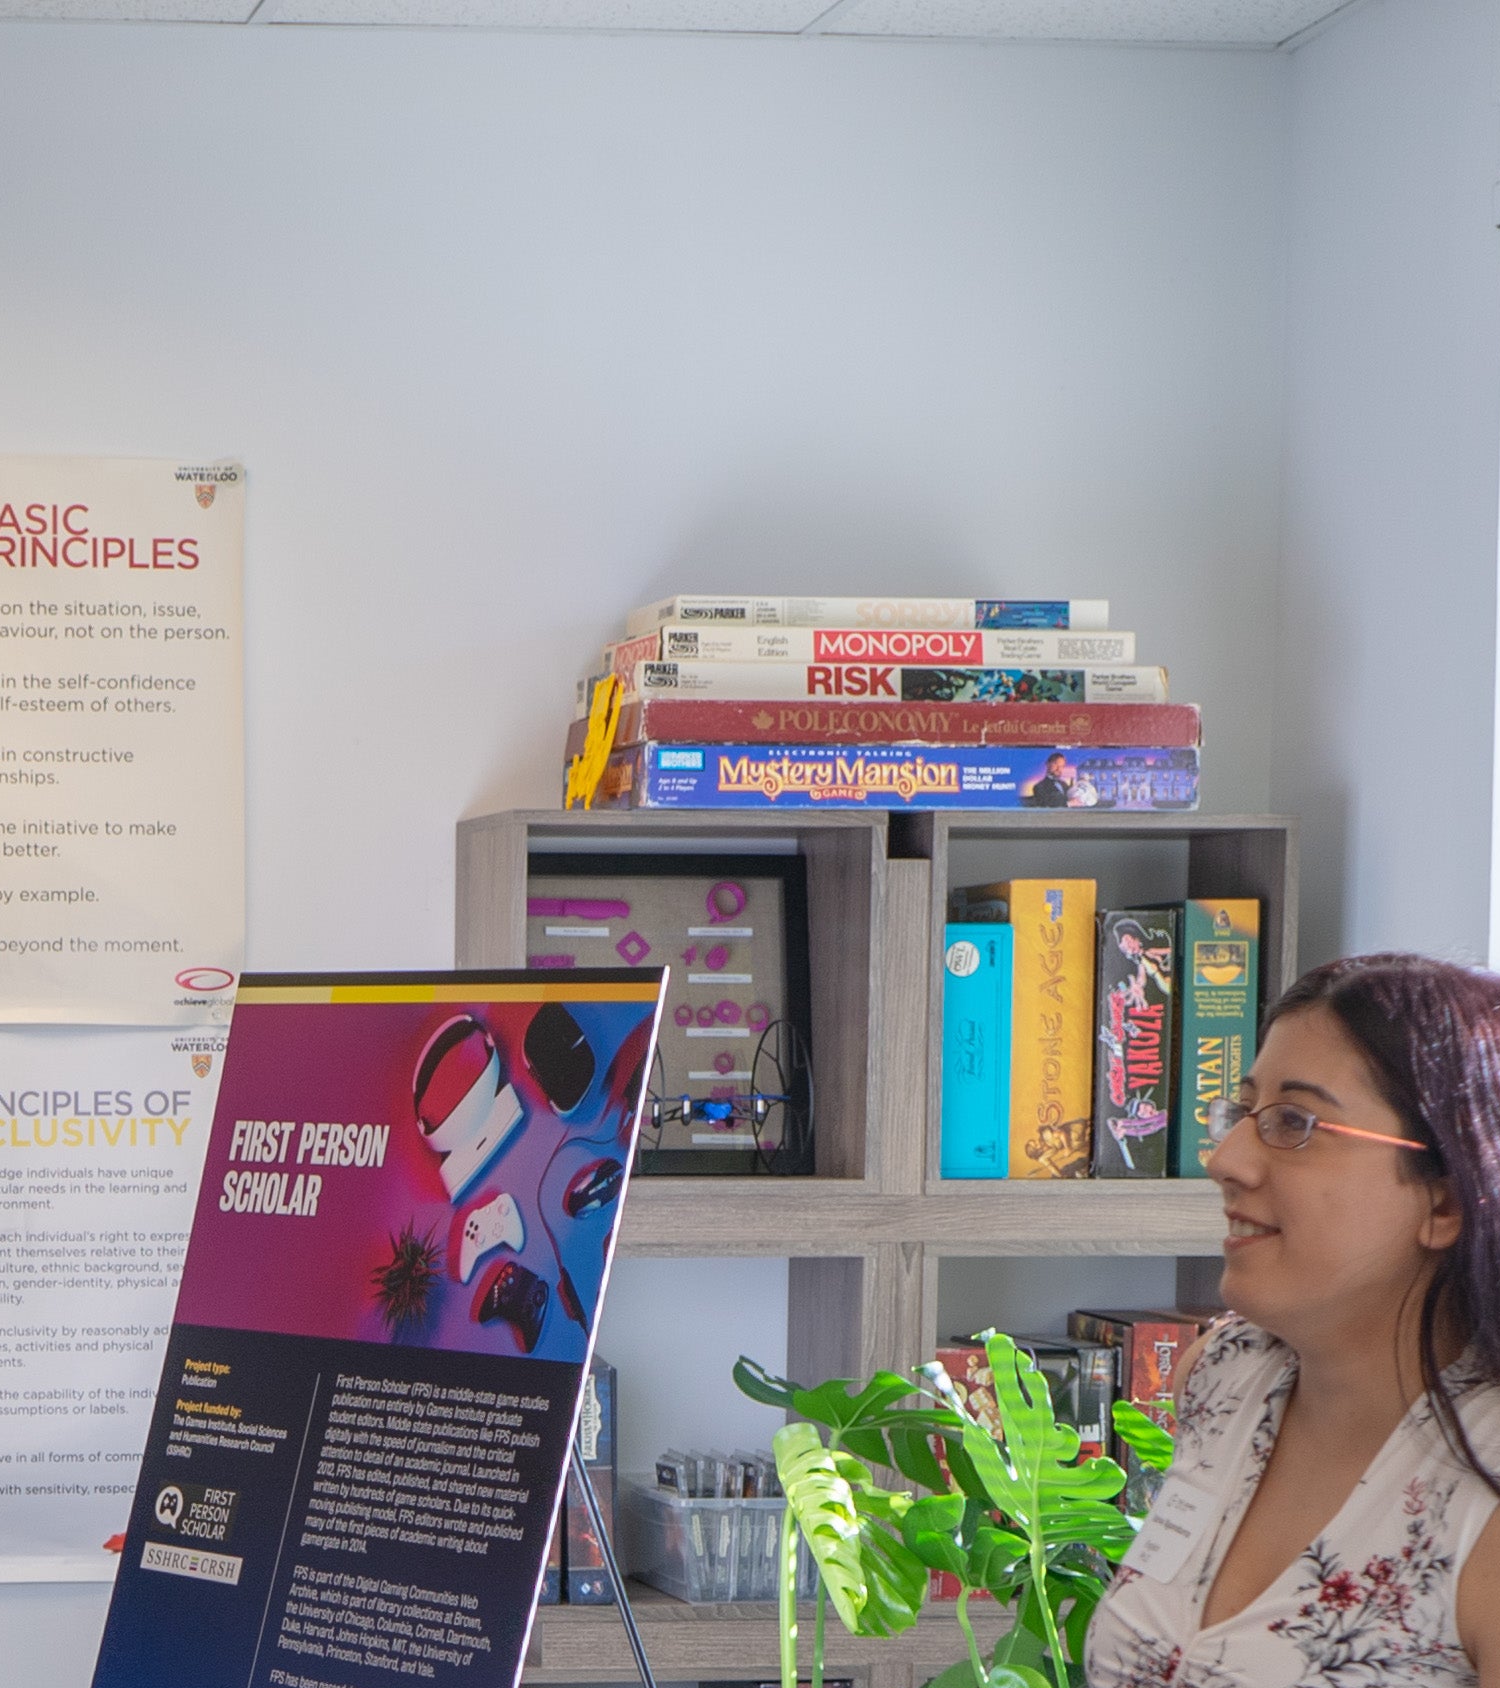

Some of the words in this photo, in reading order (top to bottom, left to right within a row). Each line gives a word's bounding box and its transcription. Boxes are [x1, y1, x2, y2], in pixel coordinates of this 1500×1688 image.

[0, 603, 24, 616] on
[28, 599, 59, 617] the
[63, 600, 147, 619] situation,
[152, 601, 202, 620] issue,
[854, 602, 973, 628] SORRY!
[63, 624, 95, 640] not
[99, 626, 124, 640] on
[128, 623, 159, 640] the
[163, 627, 231, 643] person.
[757, 635, 788, 646] English
[758, 648, 788, 657] Edition
[818, 632, 977, 658] MONOPOLY
[22, 673, 53, 690] the
[57, 673, 197, 692] self-confidence
[806, 665, 898, 697] RISK
[89, 696, 109, 713] of
[113, 697, 176, 714] others.
[778, 708, 952, 735] POLECONOMY
[962, 719, 980, 734] Le
[22, 747, 135, 764] constructive
[768, 749, 848, 757] ELECTRONIC
[718, 755, 832, 800] Mystery
[834, 756, 960, 801] Mansion
[822, 788, 853, 798] GAME
[22, 820, 99, 836] initiative
[104, 821, 124, 836] to
[128, 820, 178, 837] make
[2, 841, 63, 858] better.
[18, 886, 100, 905] example.
[69, 937, 99, 953] the
[104, 938, 184, 953] moment.
[1038, 922, 1066, 1004] AGE
[170, 1042, 227, 1053] WATERLO
[1126, 1003, 1165, 1090] YAKUZA
[1037, 1011, 1064, 1129] STONE
[143, 1090, 192, 1118] OF
[229, 1120, 296, 1163] FIRST
[296, 1122, 390, 1167] PERSON
[26, 1167, 94, 1179] individuals
[97, 1167, 127, 1179] have
[130, 1169, 174, 1180] unique
[219, 1170, 322, 1216] SCHOLAR
[184, 1358, 213, 1373] Project
[211, 1362, 231, 1376] type:
[181, 1373, 218, 1388] Publication
[175, 1398, 204, 1413] Project
[202, 1402, 231, 1416] funded
[229, 1405, 242, 1419] by:
[203, 1488, 236, 1506] FIRST
[189, 1502, 230, 1523] PERSON
[180, 1518, 226, 1541] SCHOLAR
[146, 1548, 189, 1570] SSHRC
[200, 1557, 236, 1579] CRSH
